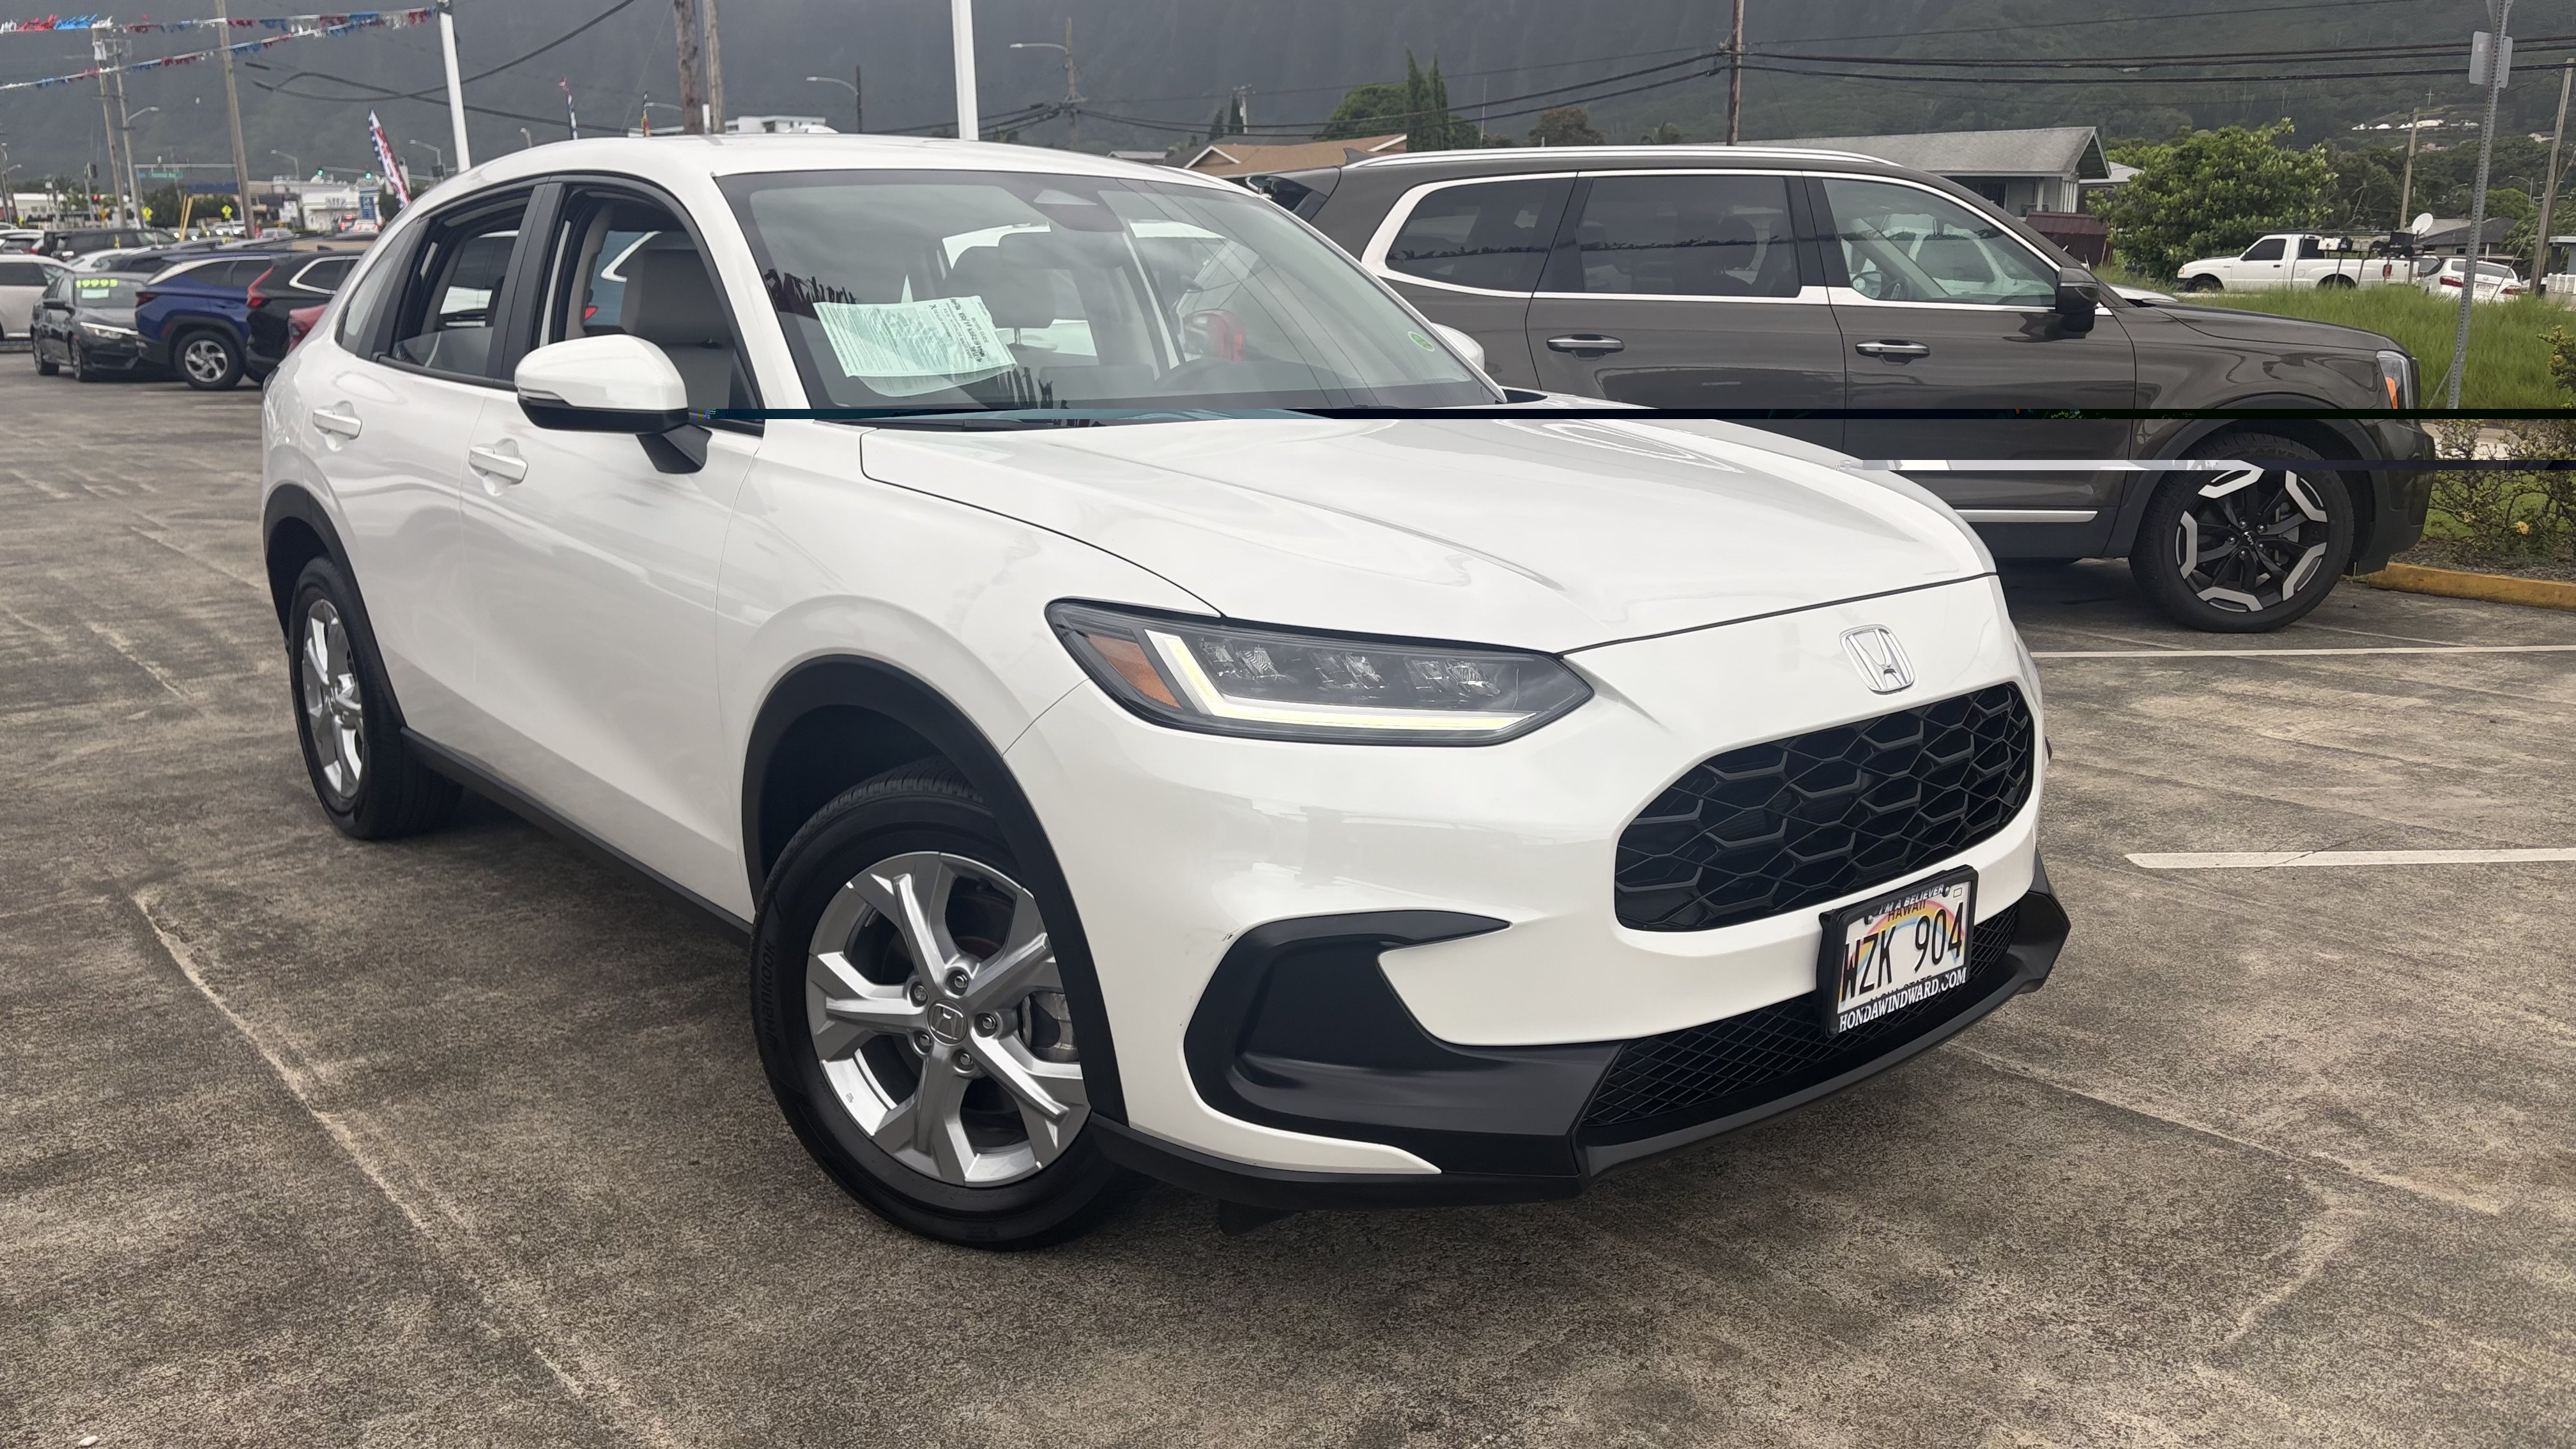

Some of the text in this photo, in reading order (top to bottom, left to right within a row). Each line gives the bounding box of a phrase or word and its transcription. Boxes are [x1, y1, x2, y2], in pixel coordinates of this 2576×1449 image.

[76, 279, 118, 288] 19995
[1903, 884, 1944, 907] BELIEVER
[1887, 900, 1926, 922] HAWAII
[1841, 902, 1963, 1002] WZK 904
[1838, 967, 1967, 1032] HONDAWINDWARD.COM
